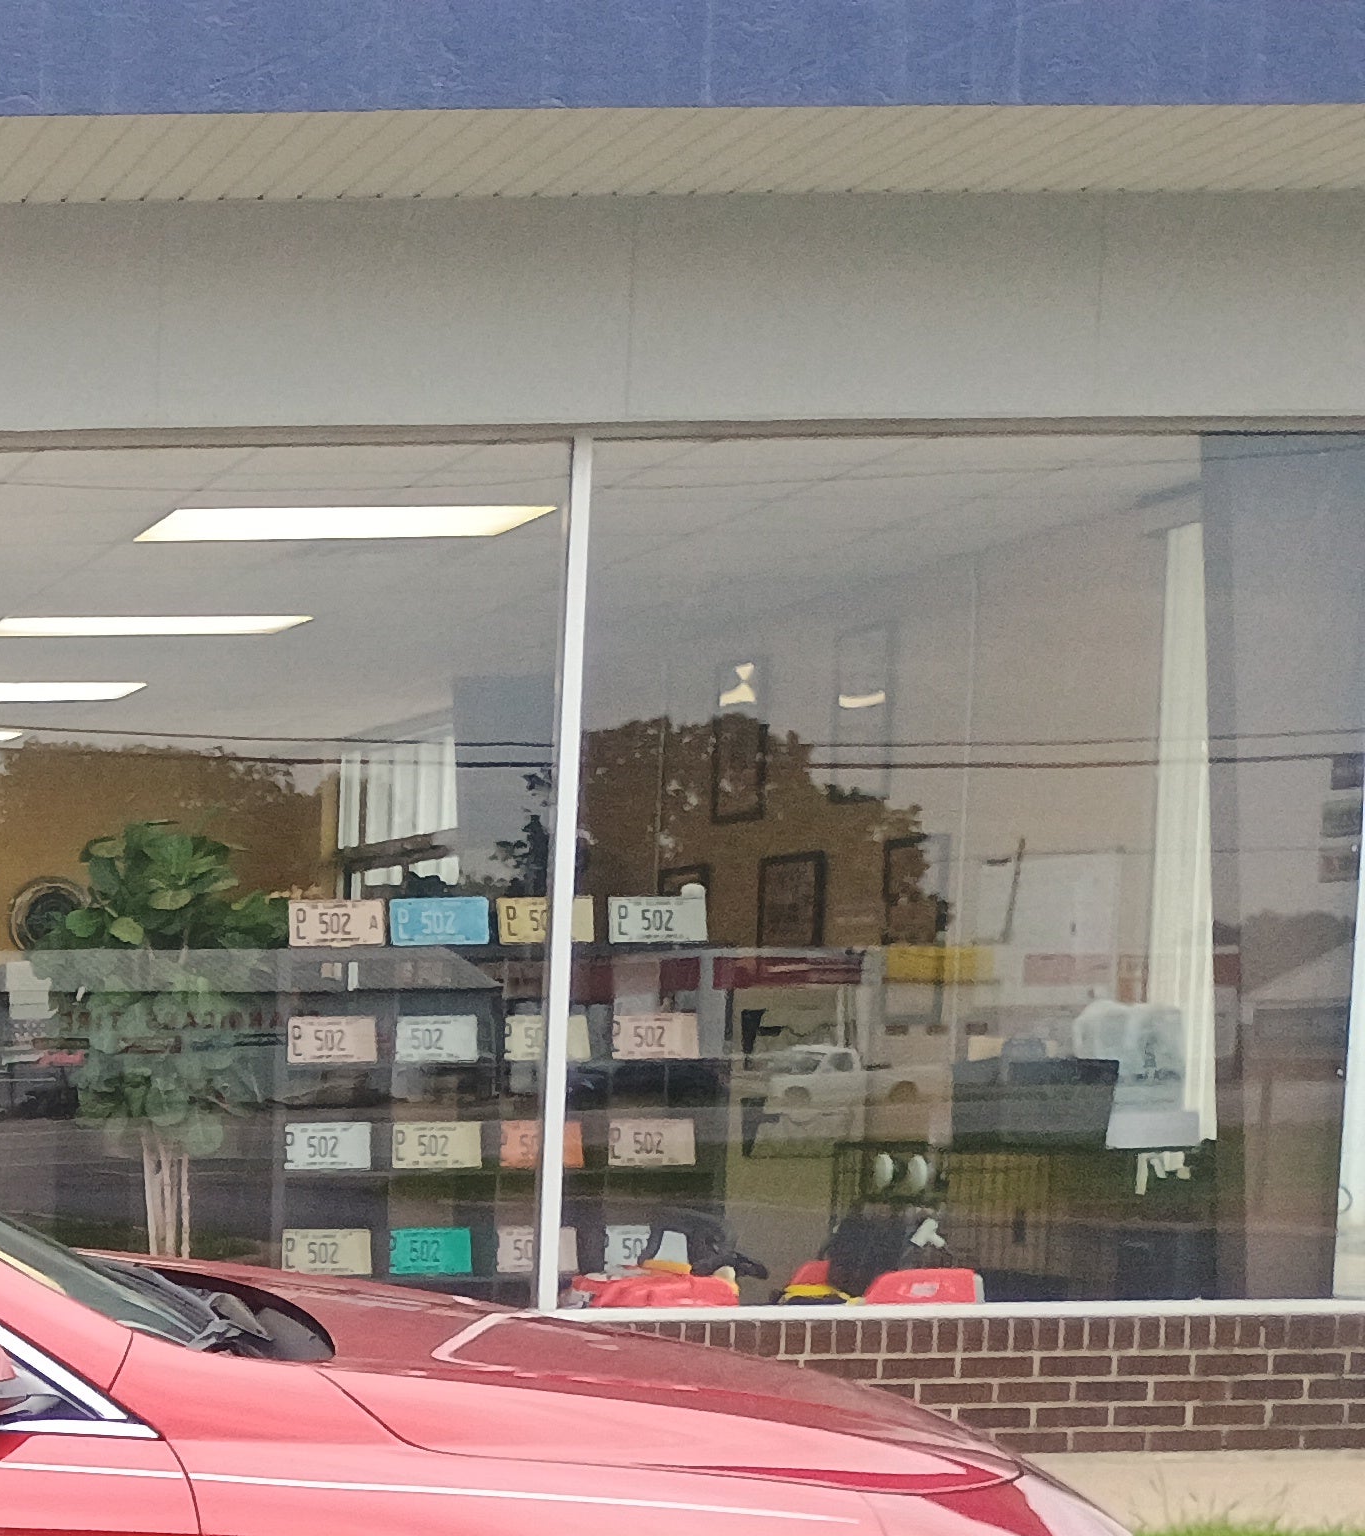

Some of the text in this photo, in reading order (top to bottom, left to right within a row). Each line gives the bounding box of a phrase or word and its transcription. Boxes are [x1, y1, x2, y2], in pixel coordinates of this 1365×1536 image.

[318, 912, 351, 936] 502
[368, 915, 378, 930] A
[421, 910, 456, 935] 502
[529, 910, 548, 932] 50
[641, 908, 674, 932] 502
[313, 1029, 346, 1052] 502
[409, 1028, 444, 1051] 502
[524, 1026, 543, 1048] 50
[633, 1025, 666, 1048] 502
[307, 1135, 339, 1158] 502
[418, 1134, 449, 1157] 502
[633, 1131, 665, 1154] 502
[307, 1241, 340, 1264] 502
[409, 1240, 441, 1263] 502
[513, 1239, 533, 1261] 50
[622, 1237, 644, 1260] 50
